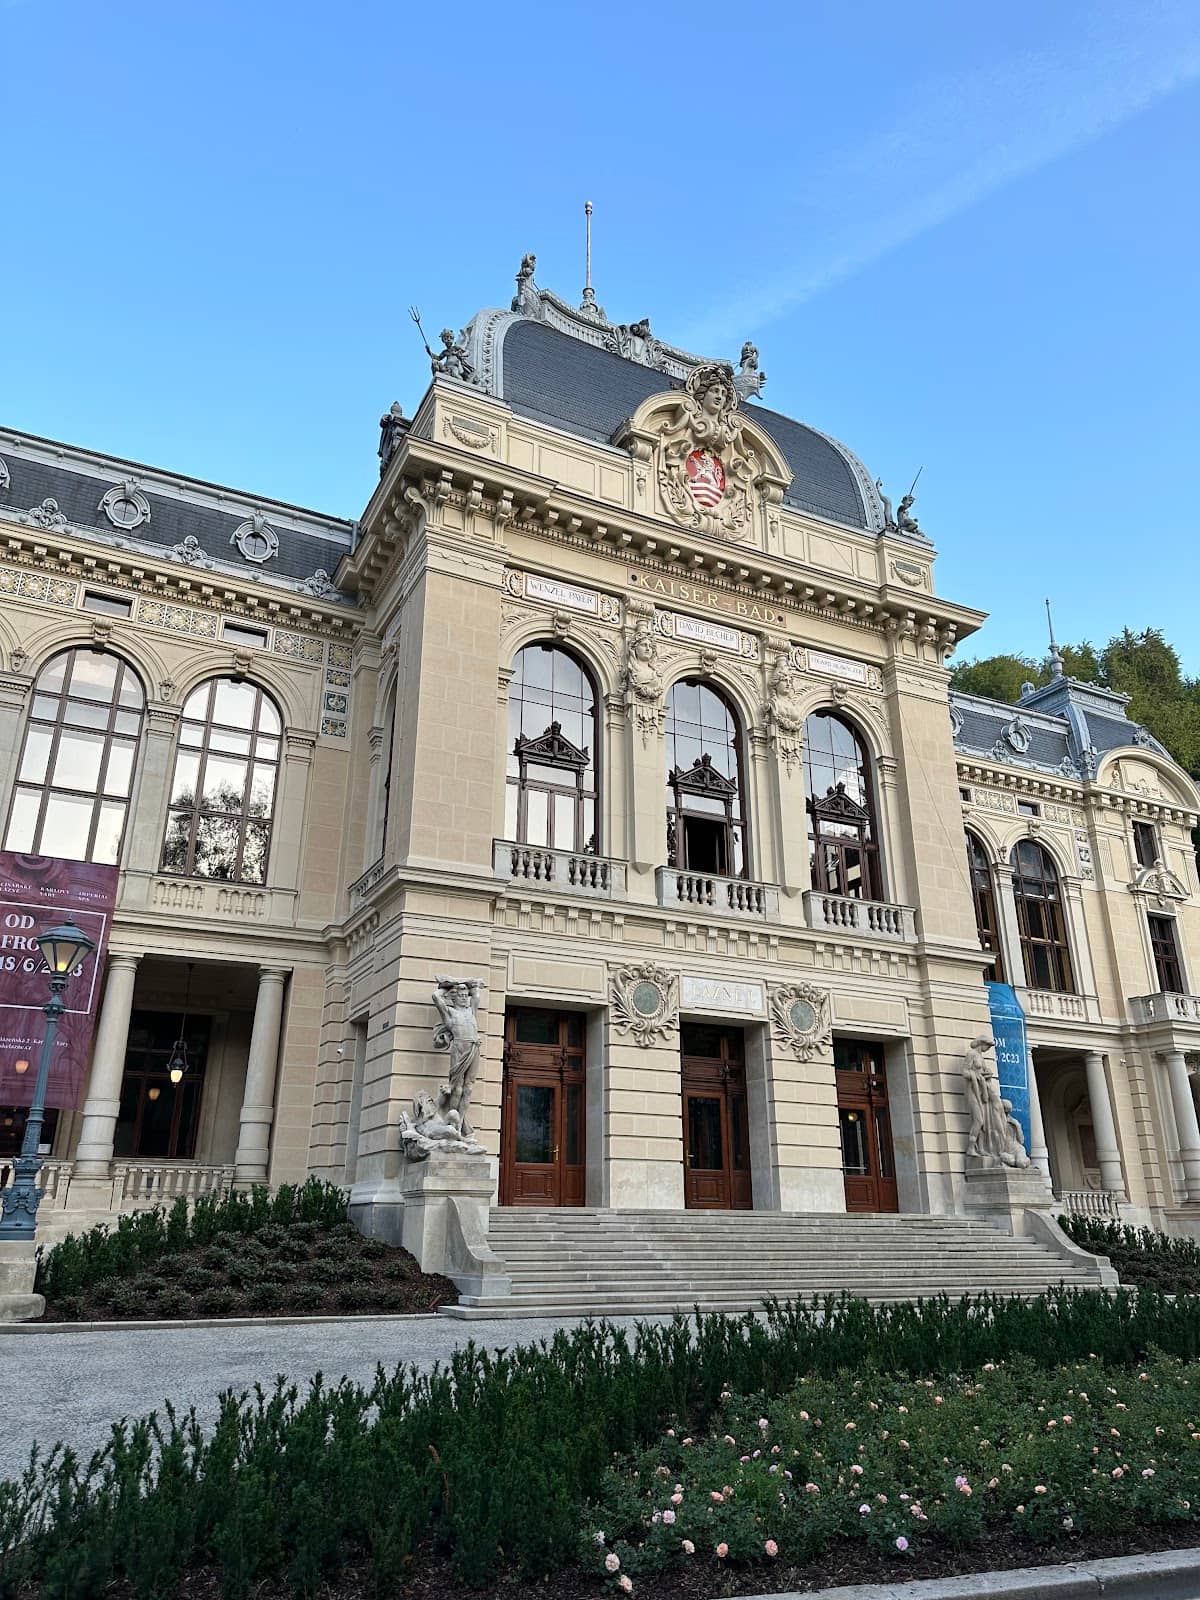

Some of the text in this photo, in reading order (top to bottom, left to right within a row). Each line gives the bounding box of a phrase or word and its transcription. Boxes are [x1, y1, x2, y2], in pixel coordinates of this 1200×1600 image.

[529, 580, 566, 599] WENZEL
[5, 913, 35, 929] OD
[1, 934, 40, 951] FRO
